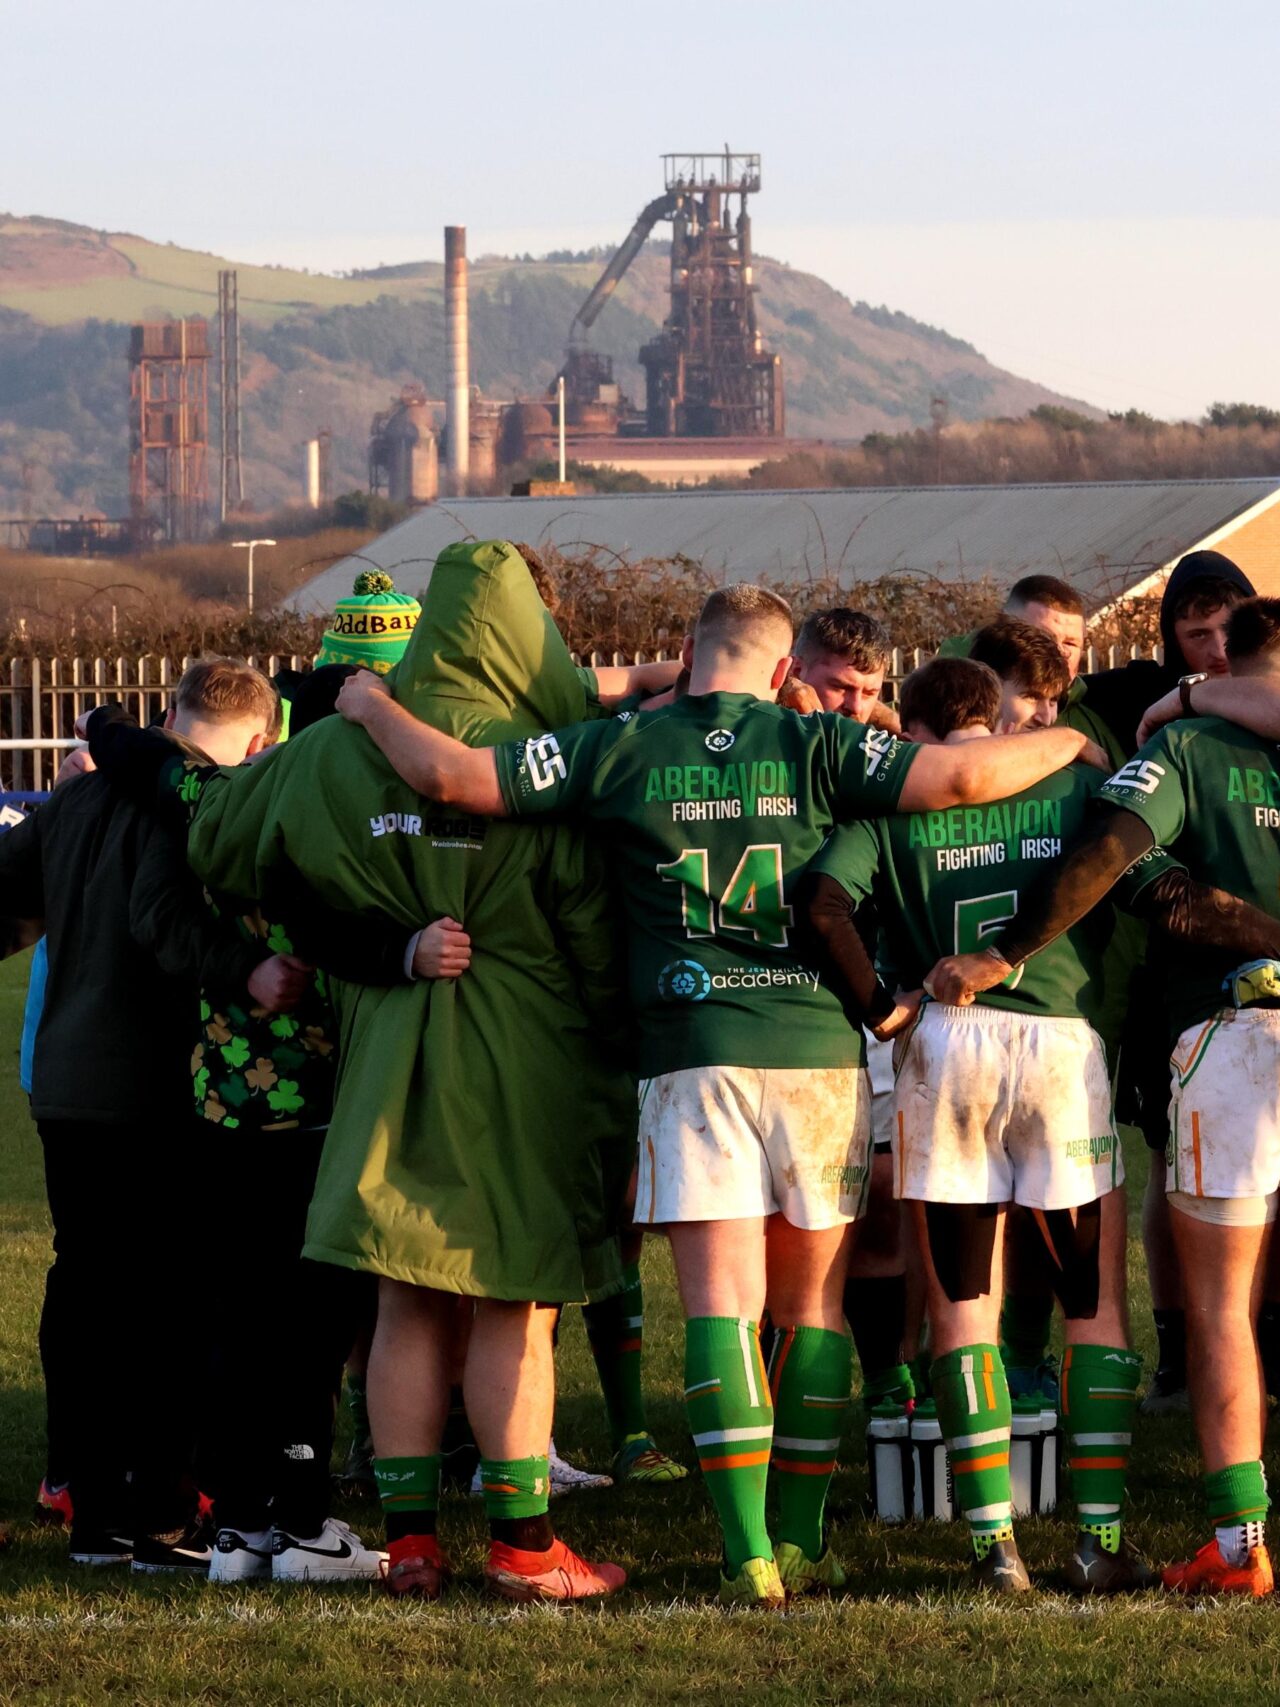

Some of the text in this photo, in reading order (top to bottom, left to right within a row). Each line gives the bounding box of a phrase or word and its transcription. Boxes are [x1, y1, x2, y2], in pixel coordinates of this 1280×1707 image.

[645, 760, 797, 816] ABERAVON
[369, 812, 422, 837] YOUR
[672, 797, 797, 822] FIGHTING IRISH
[908, 799, 1061, 861] ABERAVON
[936, 838, 1061, 872] FIGHTING IRISH
[656, 843, 795, 948] 14
[711, 968, 820, 992] academy
[1066, 1136, 1112, 1164] ABERAVON
